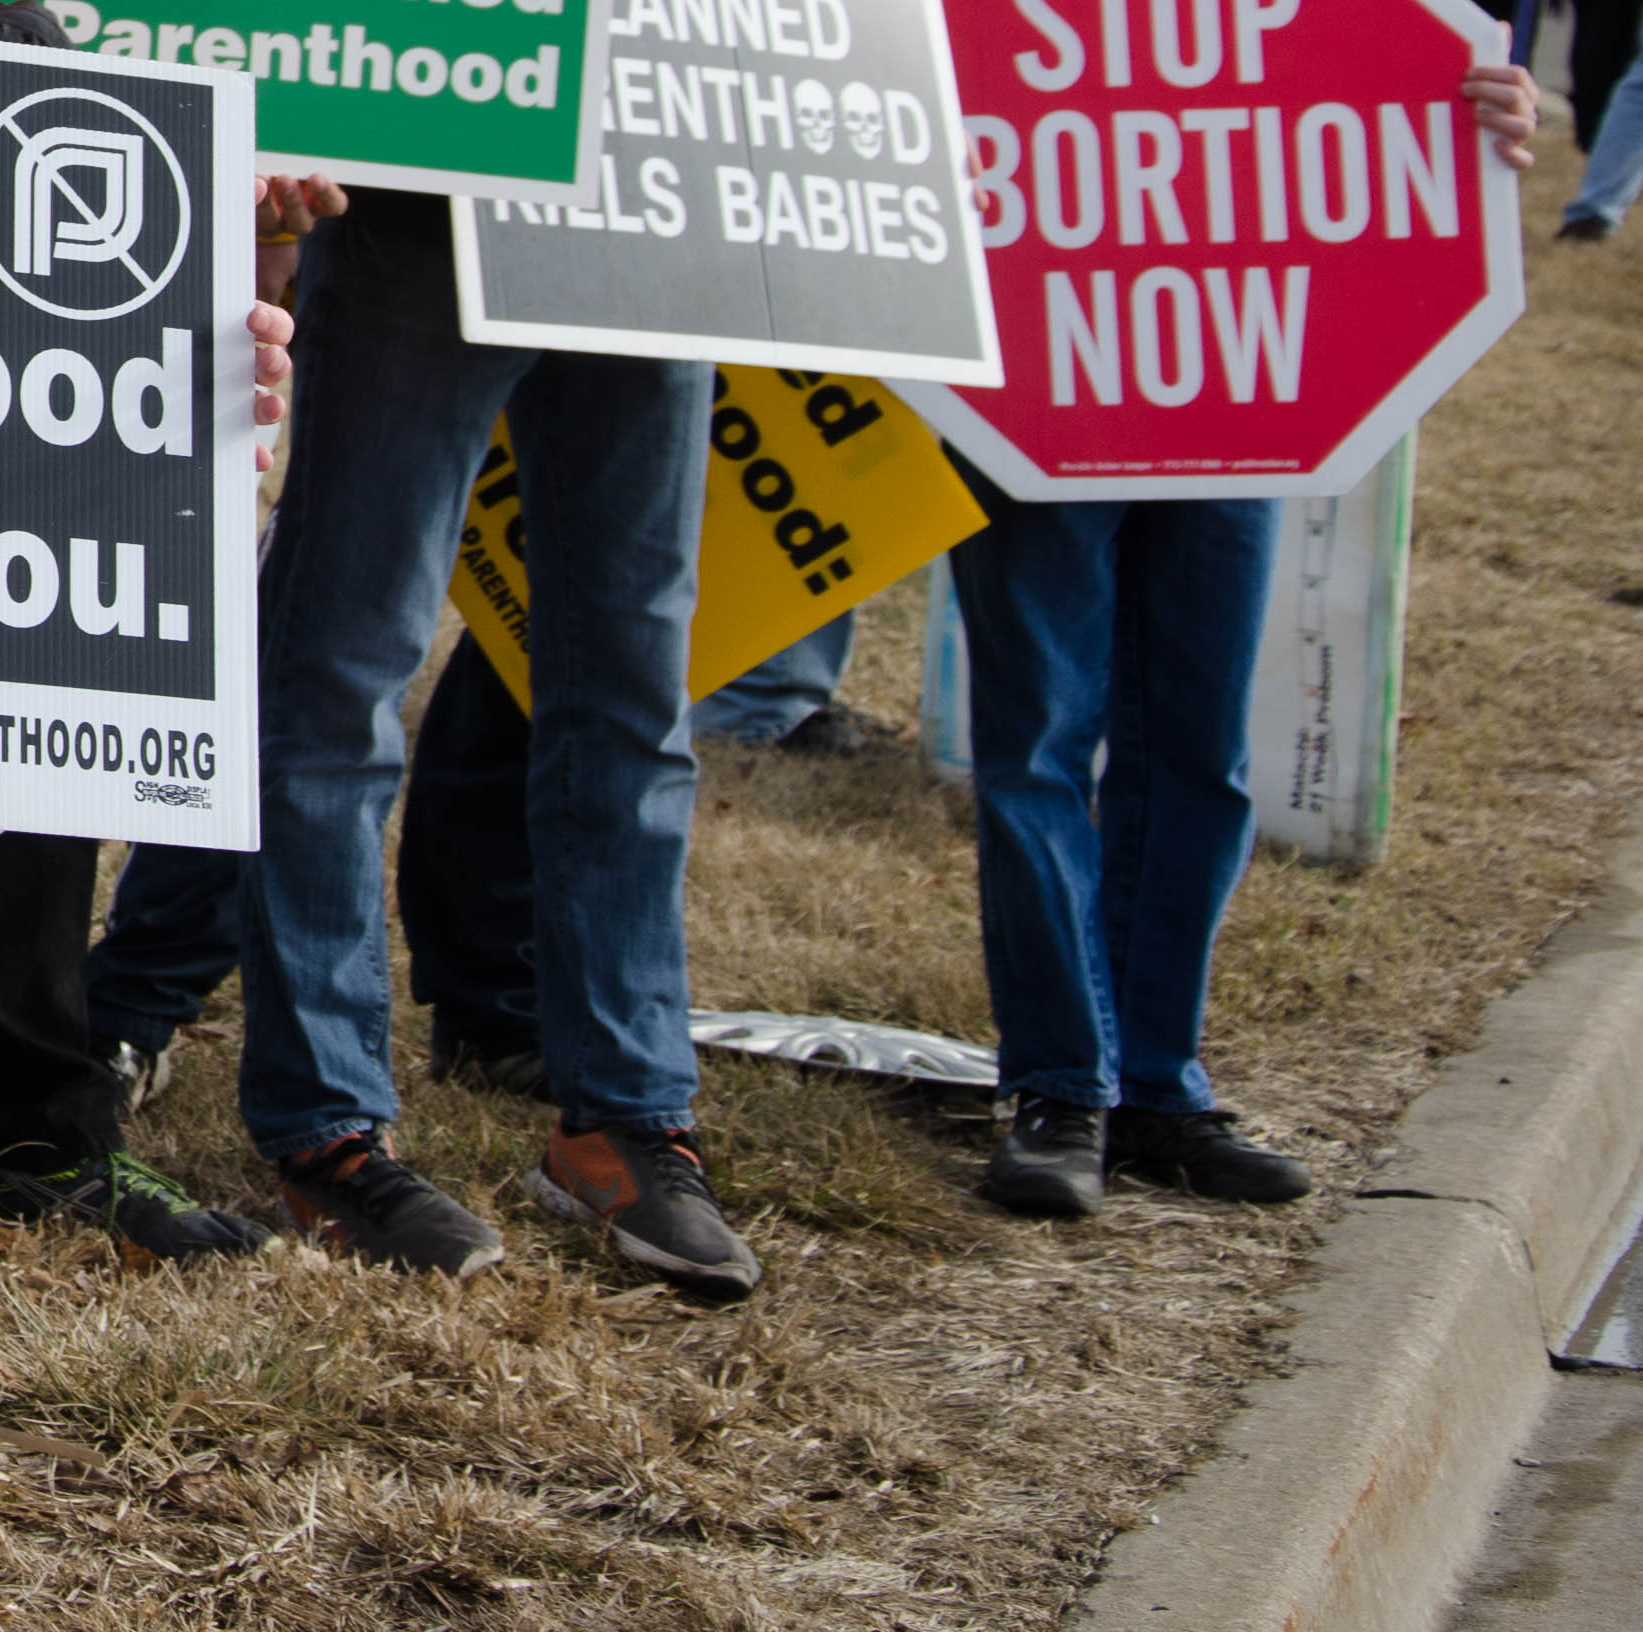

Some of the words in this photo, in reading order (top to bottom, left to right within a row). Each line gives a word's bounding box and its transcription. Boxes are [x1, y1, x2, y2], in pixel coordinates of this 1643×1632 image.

[715, 165, 948, 263] BABIES
[1044, 266, 1311, 408] NOW
[461, 525, 530, 654] PARENTH
